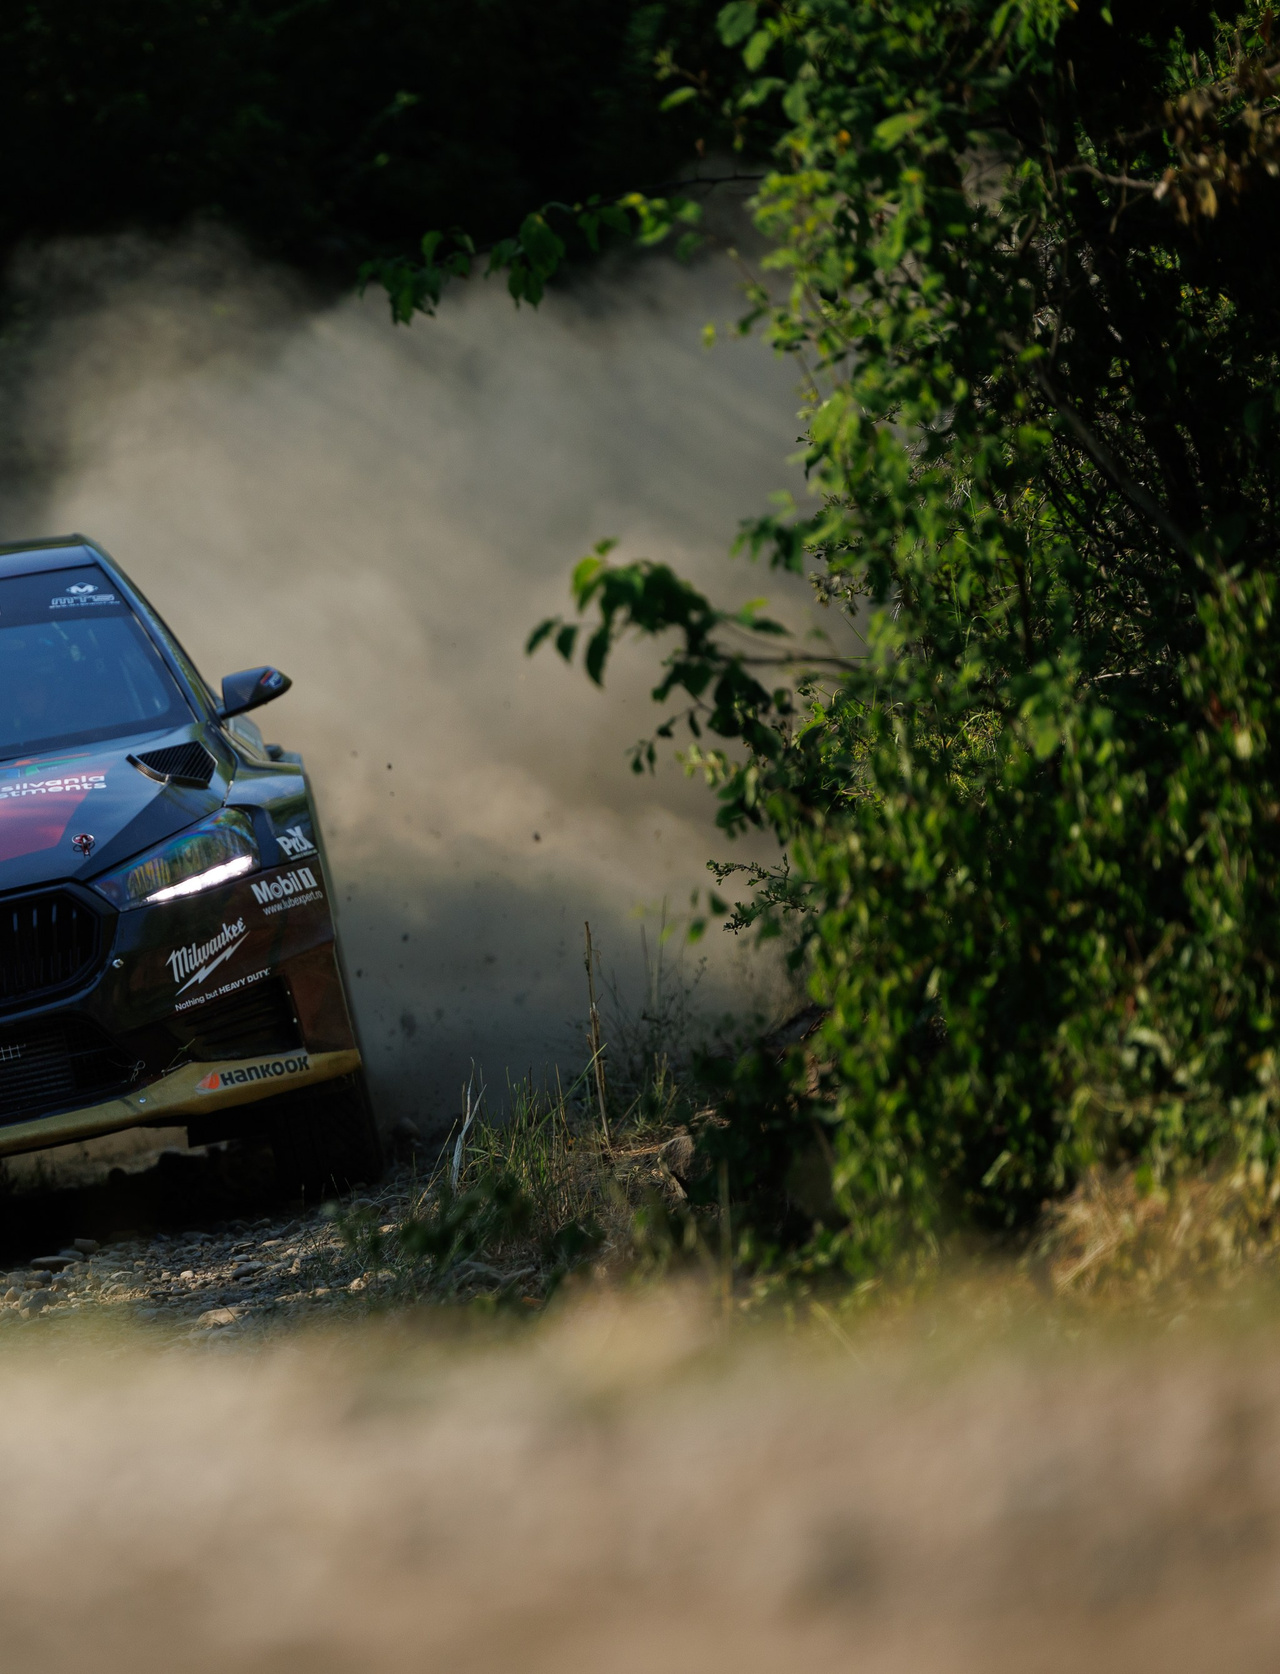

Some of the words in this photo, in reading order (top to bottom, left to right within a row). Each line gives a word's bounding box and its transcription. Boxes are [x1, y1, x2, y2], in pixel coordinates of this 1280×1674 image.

[250, 871, 303, 904] Mobil
[297, 867, 318, 889] 1
[262, 890, 324, 916] www.lubexpert.ro
[165, 921, 246, 984] Milwaukee
[175, 995, 205, 1012] Nothing
[205, 990, 219, 1001] but
[219, 978, 246, 995] HEAVY
